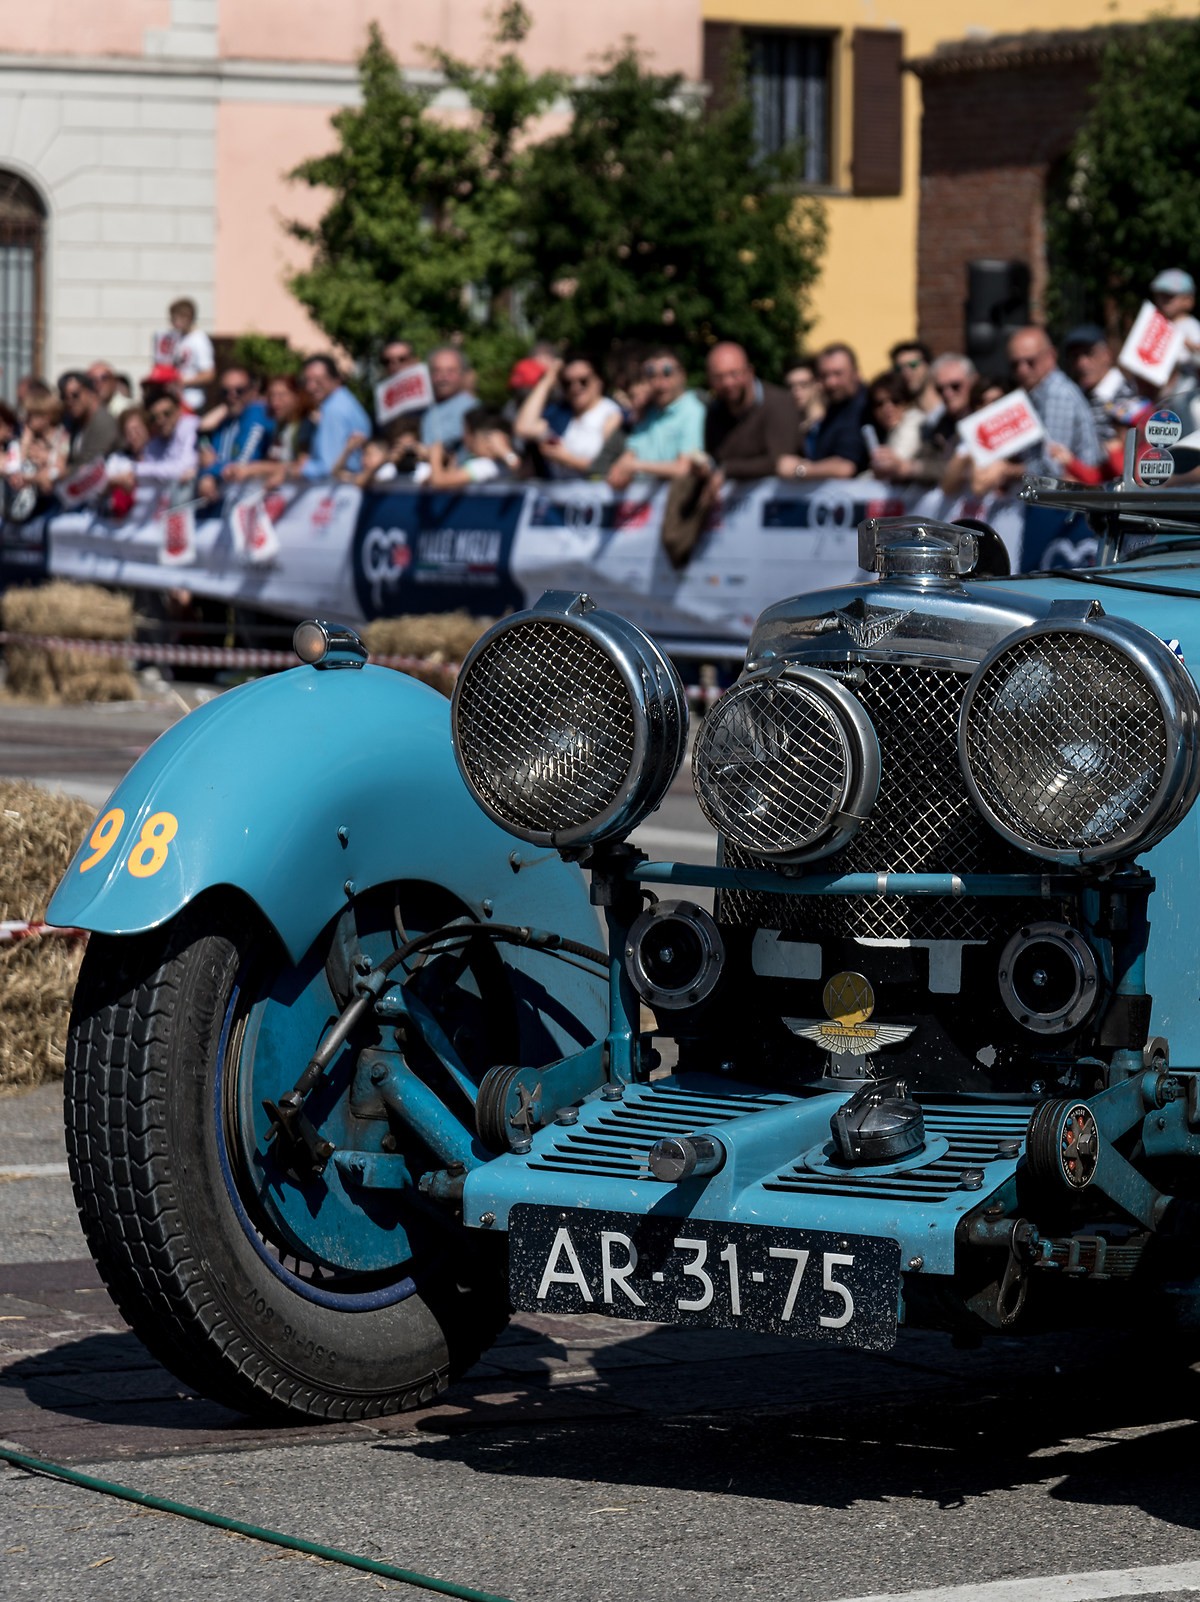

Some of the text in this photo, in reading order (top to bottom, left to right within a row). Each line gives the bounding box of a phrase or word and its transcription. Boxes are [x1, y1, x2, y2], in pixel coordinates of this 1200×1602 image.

[1147, 425, 1179, 436] VERIFICATO
[1140, 463, 1171, 474] VERIFICATO
[79, 806, 180, 879] 98
[536, 1226, 856, 1330] AR-31-75
